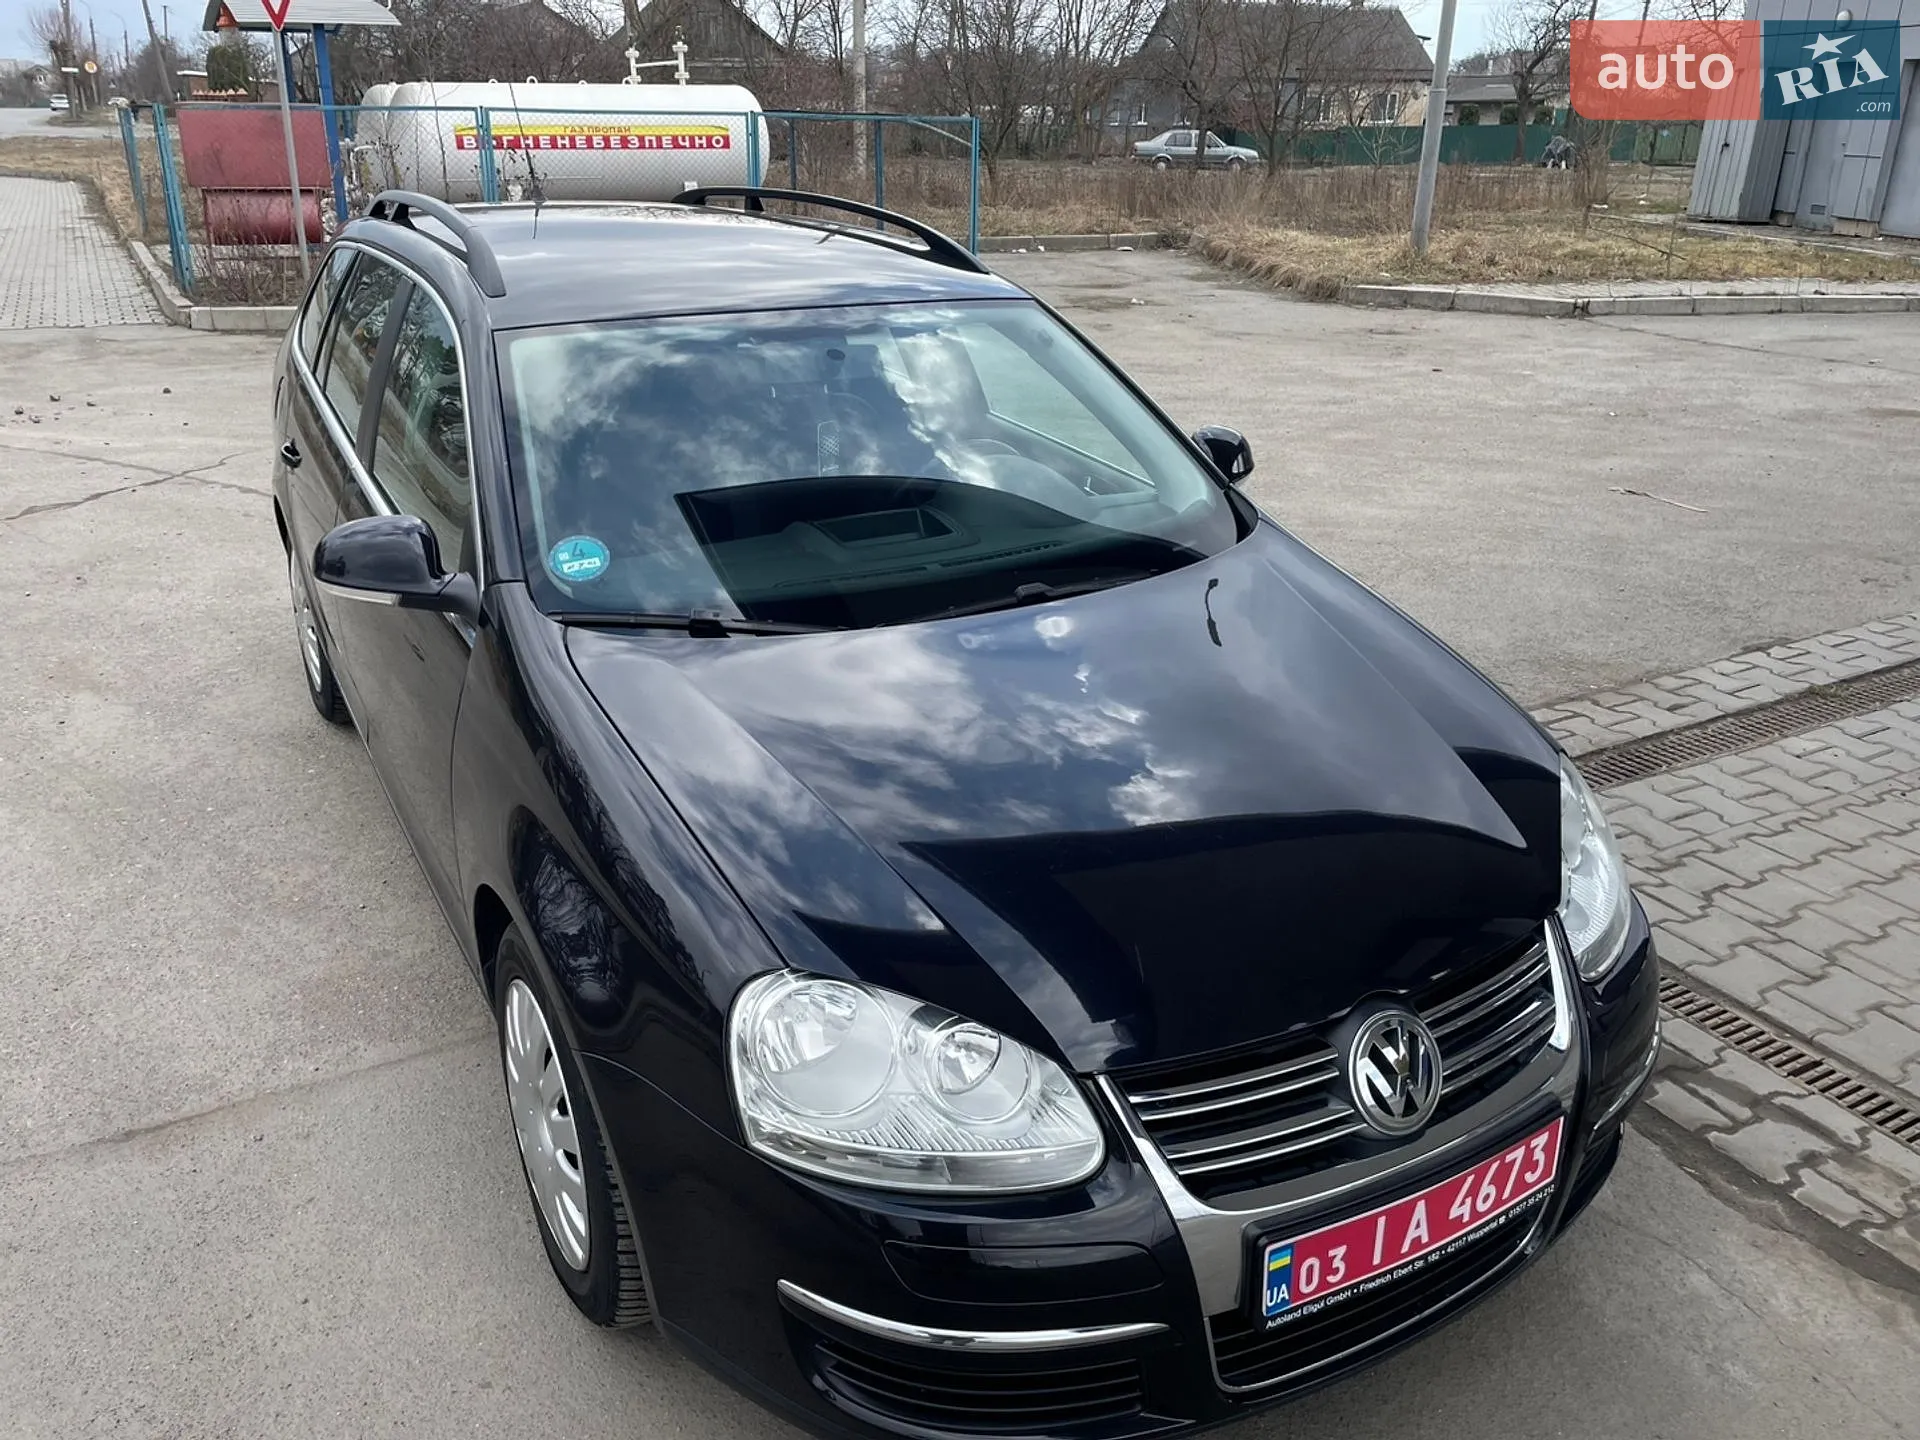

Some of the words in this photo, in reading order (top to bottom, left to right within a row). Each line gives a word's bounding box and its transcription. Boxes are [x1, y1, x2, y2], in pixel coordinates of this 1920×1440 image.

[463, 135, 726, 149] ВГНЕНЕБЕЗПЕЧНО
[563, 126, 585, 134] ГАЗ
[588, 126, 631, 134] ПРОПАН
[1299, 1245, 1348, 1294] 03
[1449, 1131, 1550, 1223] 4673
[1265, 1309, 1302, 1330] Autoland
[1326, 1290, 1352, 1305] GmbH
[1360, 1273, 1392, 1293] Friedrich
[1266, 1283, 1289, 1307] UA
